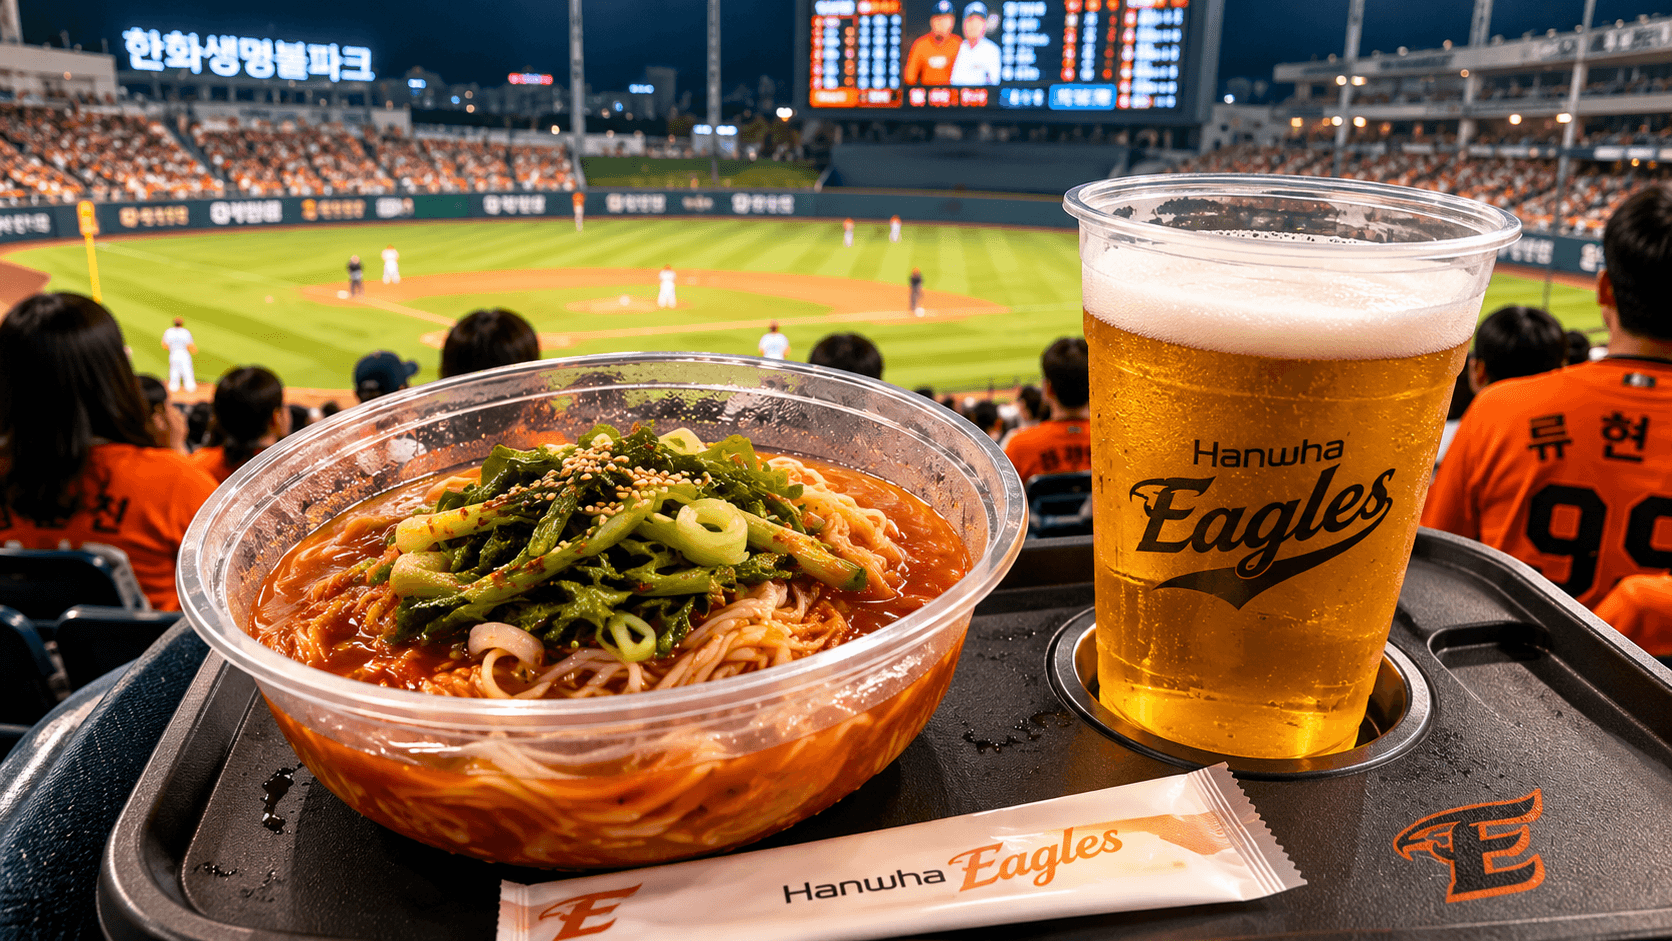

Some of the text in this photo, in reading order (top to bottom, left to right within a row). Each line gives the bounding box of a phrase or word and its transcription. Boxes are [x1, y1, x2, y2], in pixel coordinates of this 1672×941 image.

[1193, 439, 1345, 468] Hanwha
[1129, 463, 1396, 580] Eagles
[783, 827, 1123, 904] Hanwha Eagles
